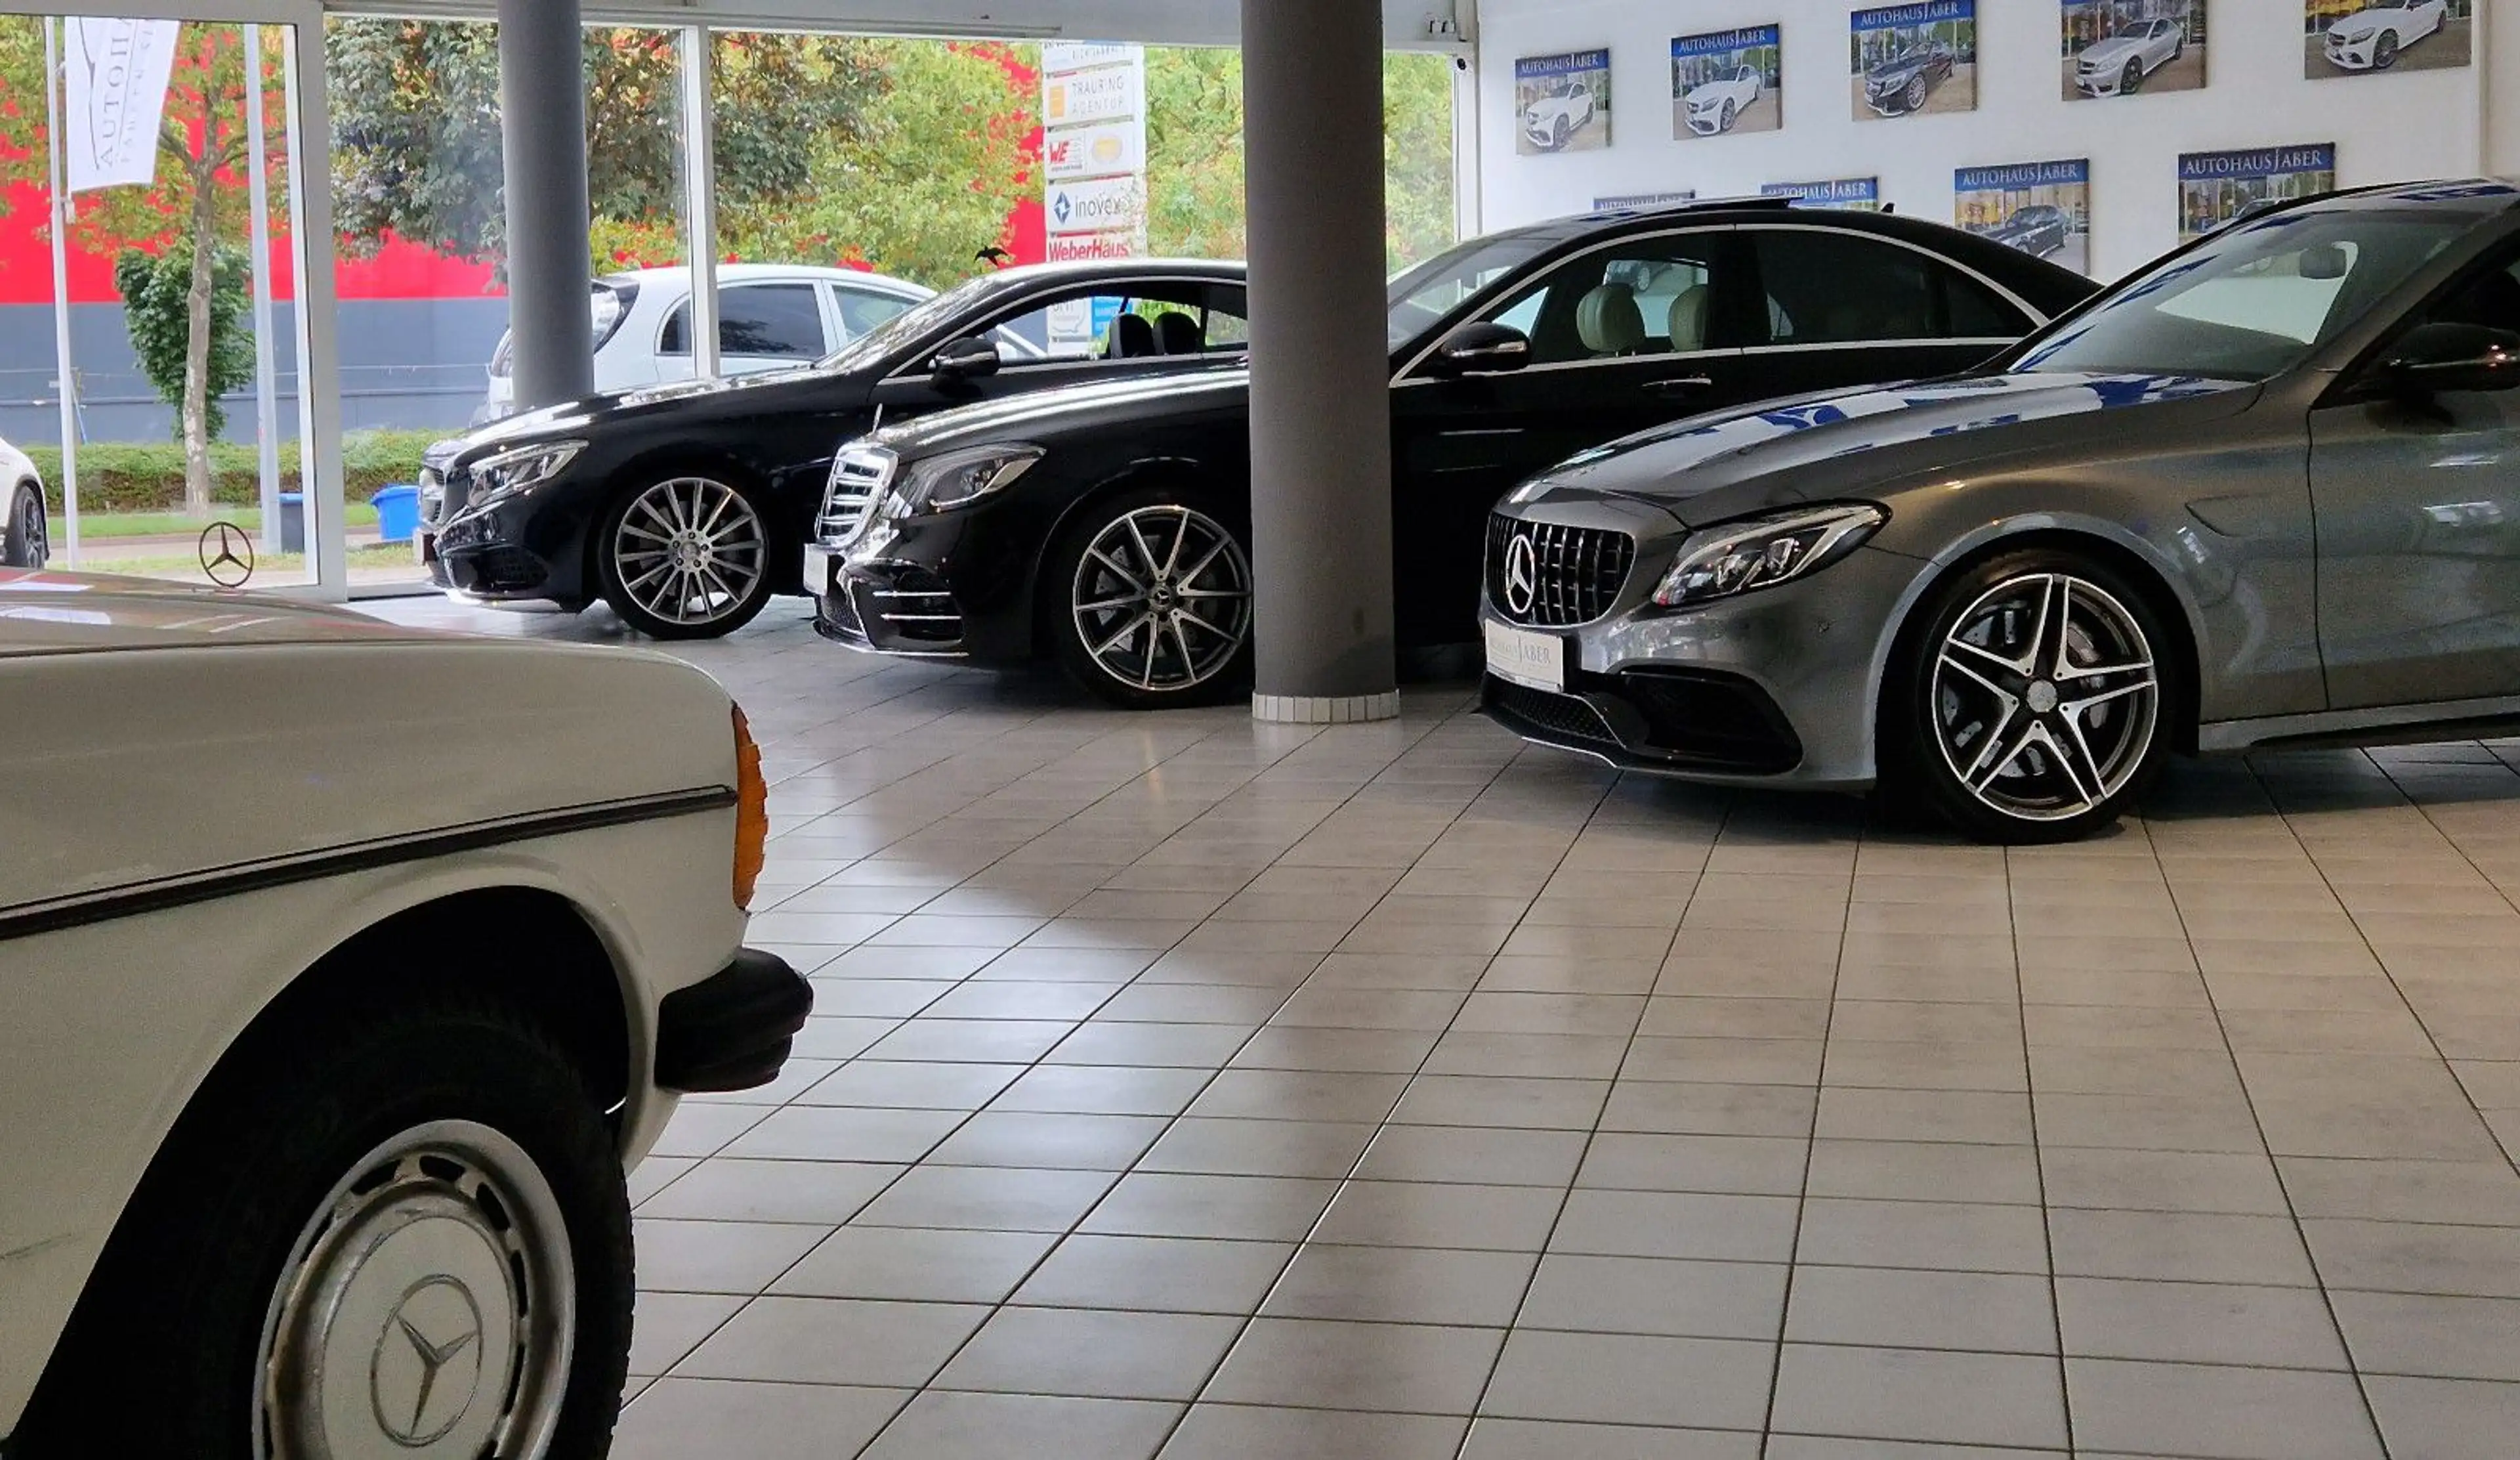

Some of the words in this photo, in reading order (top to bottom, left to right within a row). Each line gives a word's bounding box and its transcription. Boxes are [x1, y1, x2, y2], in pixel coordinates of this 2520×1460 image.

[1861, 5, 1922, 26] AUTOHAUS
[1679, 33, 1734, 53] AUTOHAUS
[1521, 56, 1570, 74] AUTOHAUS
[2184, 153, 2272, 175] AUTOHAUS
[1962, 167, 2035, 186] AUTOHAUS
[1075, 194, 1122, 219] inovex
[1049, 238, 1129, 262] WeberHaus
